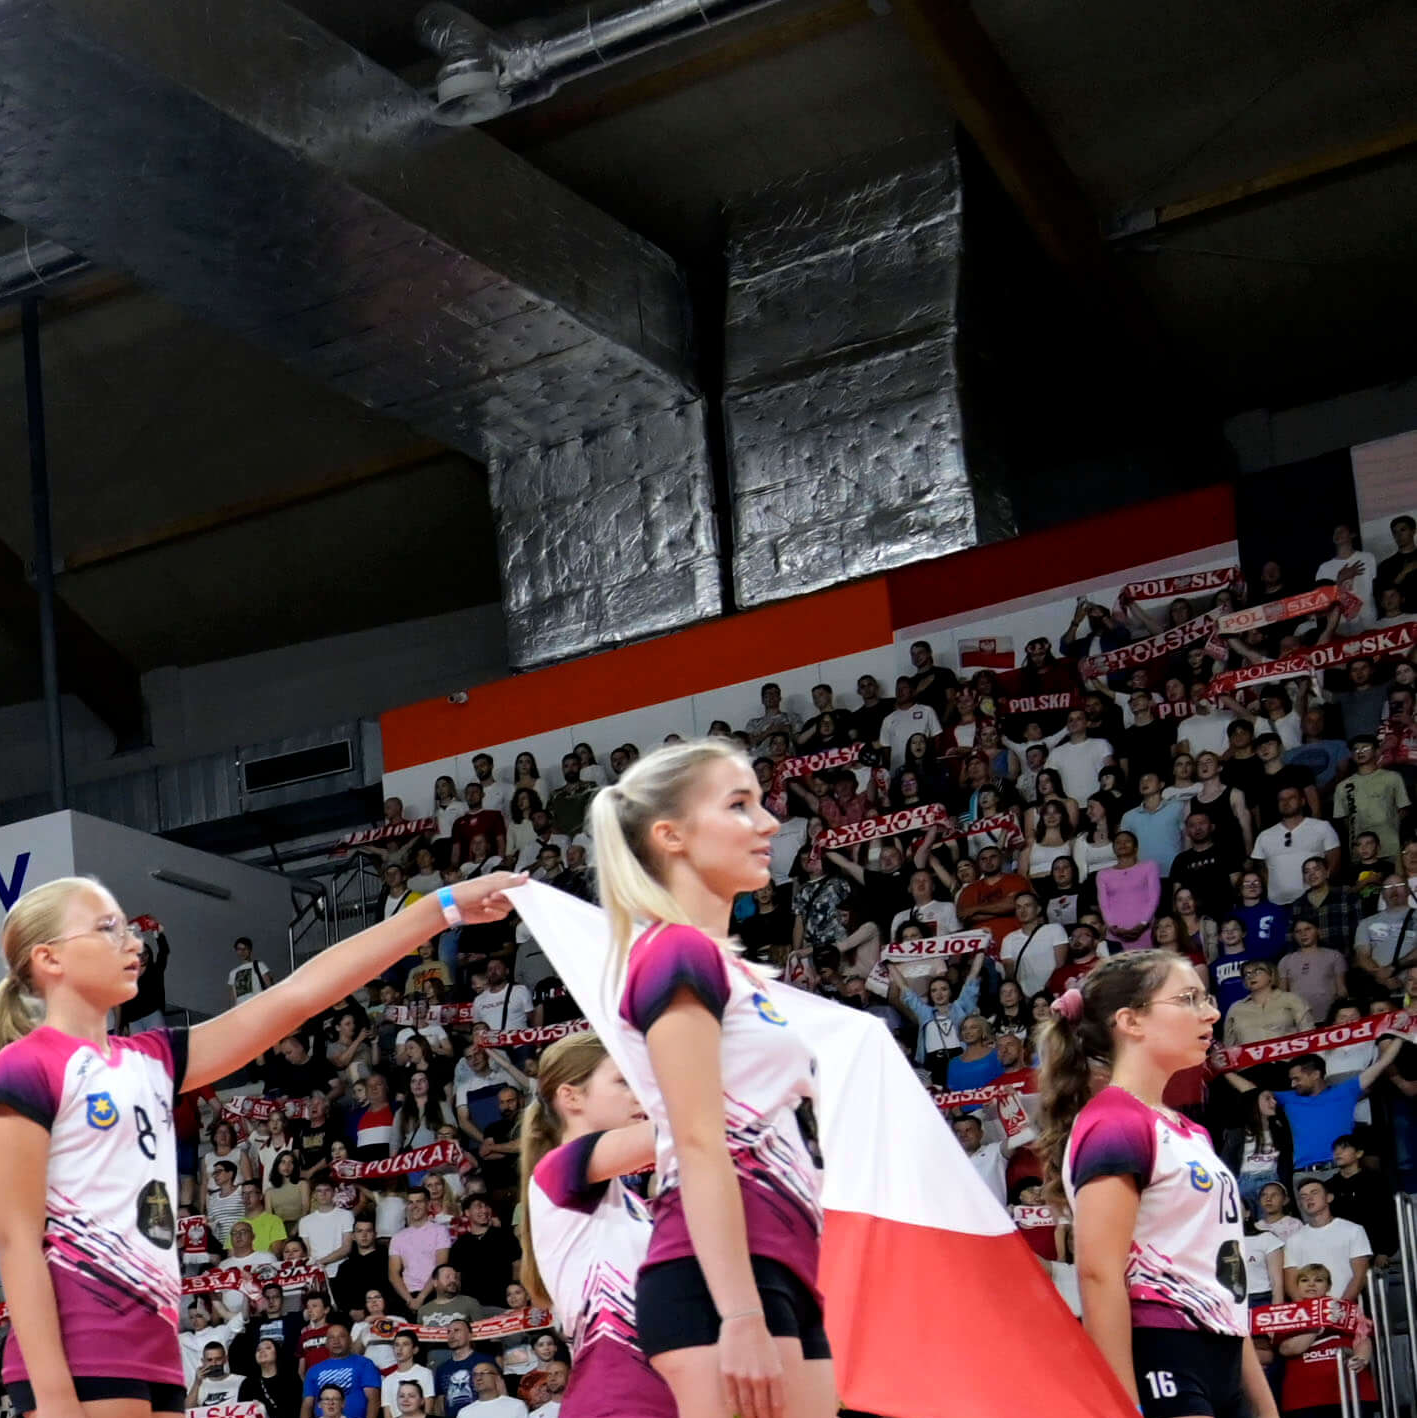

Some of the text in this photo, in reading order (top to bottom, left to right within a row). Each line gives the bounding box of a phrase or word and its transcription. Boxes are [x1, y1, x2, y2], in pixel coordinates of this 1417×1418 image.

[1236, 658, 1308, 682] POLSKA
[1009, 693, 1070, 713] POLSKA
[1246, 1021, 1375, 1061] POLSKA
[134, 1105, 157, 1160] 8
[366, 1151, 442, 1176] POLSKA
[1256, 1308, 1311, 1326] SKA
[1145, 1371, 1178, 1400] 16
